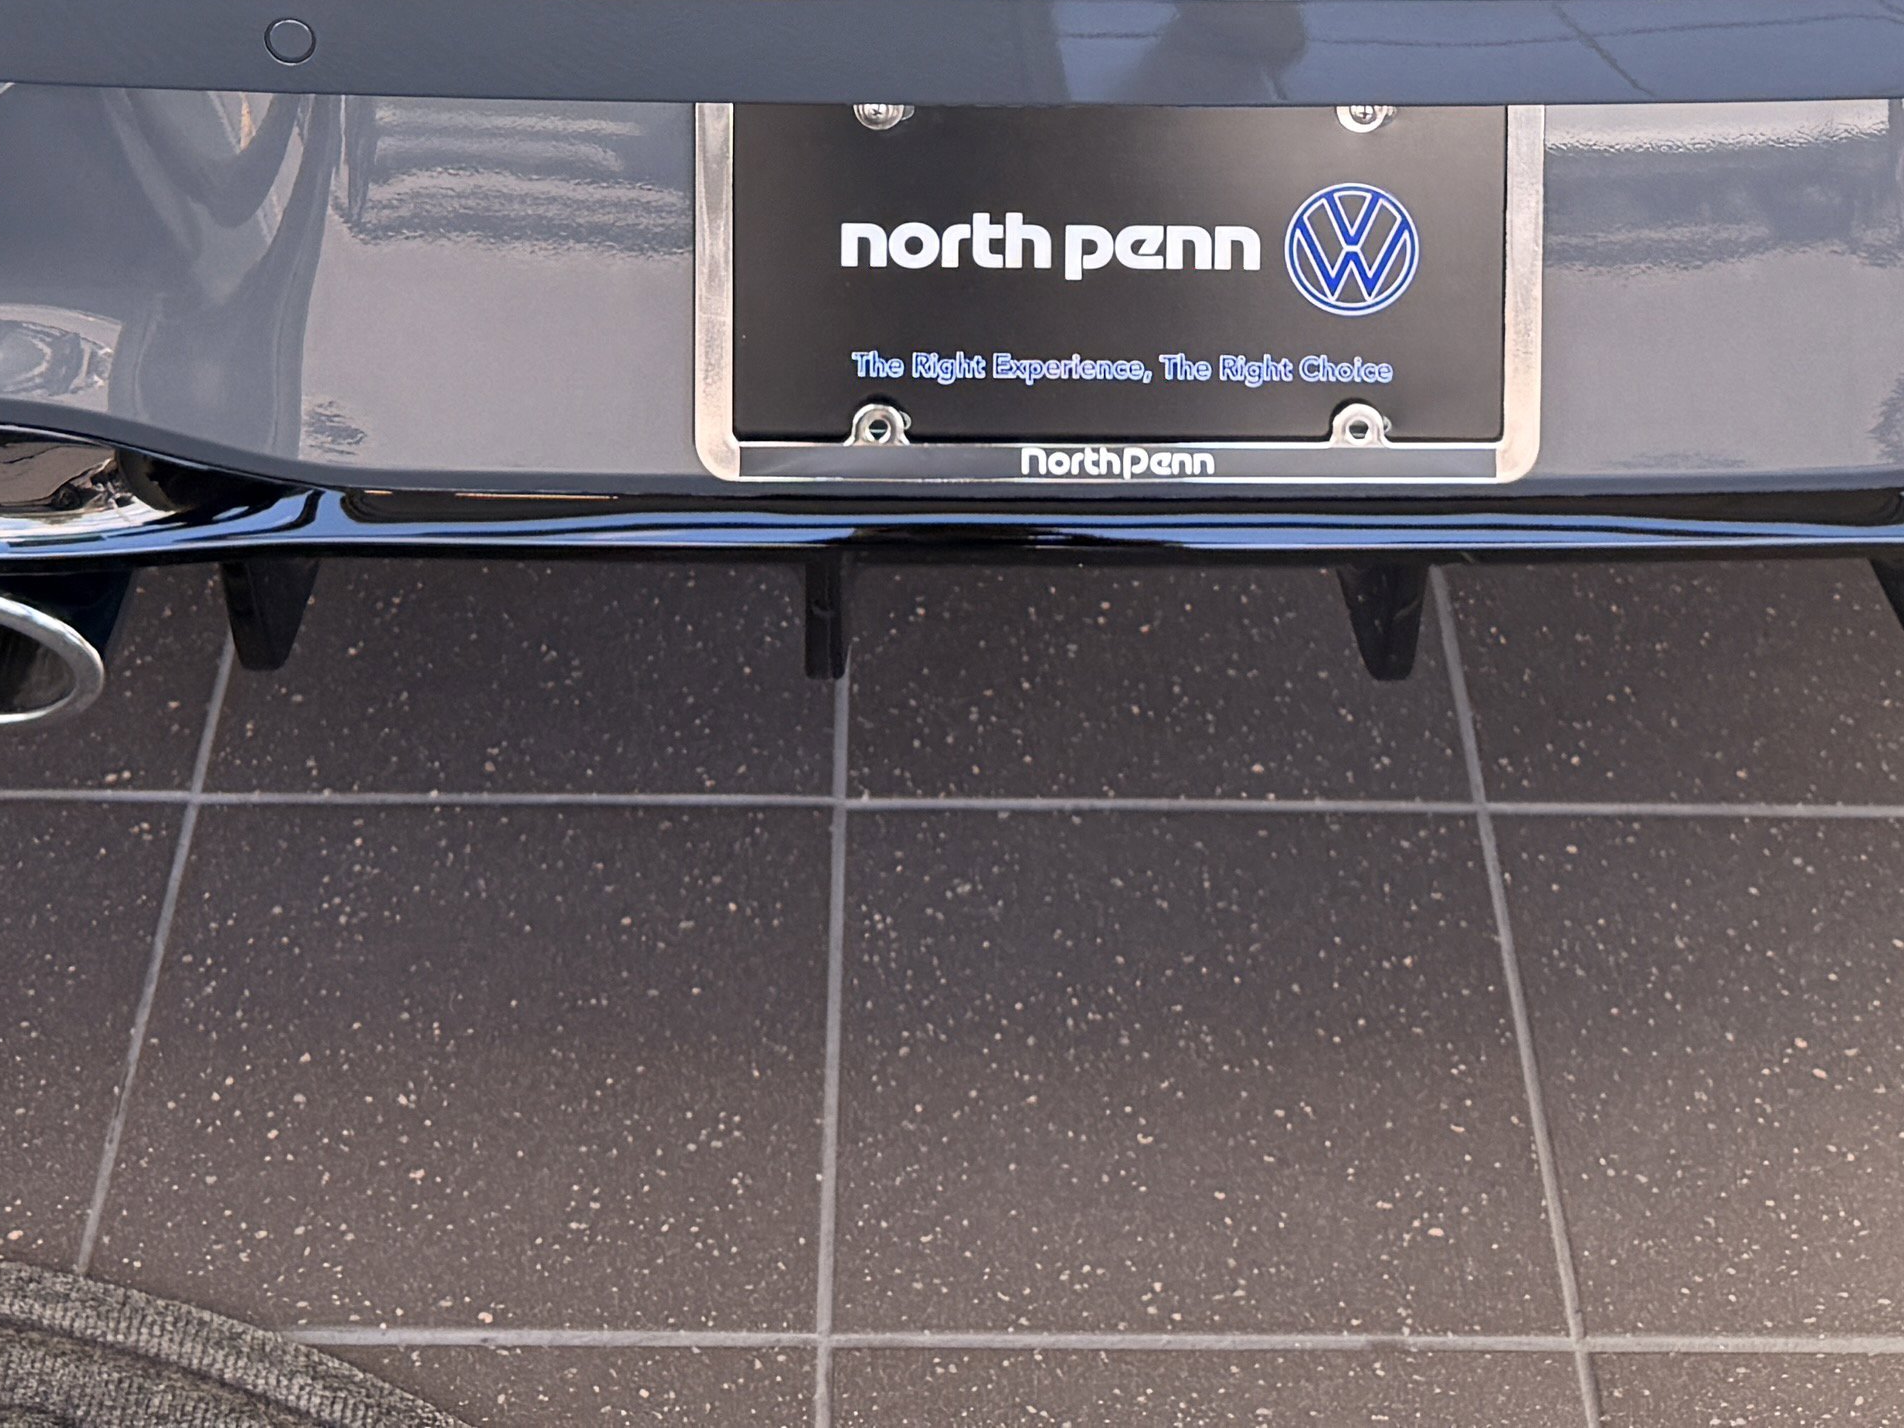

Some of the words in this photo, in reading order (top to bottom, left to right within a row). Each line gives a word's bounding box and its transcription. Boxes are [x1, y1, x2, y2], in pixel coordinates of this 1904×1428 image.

[840, 211, 1052, 270] north
[1064, 224, 1262, 281] penn
[851, 350, 905, 379] The
[911, 350, 987, 385] Right
[992, 352, 1153, 386] Experience,
[1158, 353, 1213, 382] The
[1218, 353, 1294, 388] Right
[1298, 355, 1394, 384] Choice
